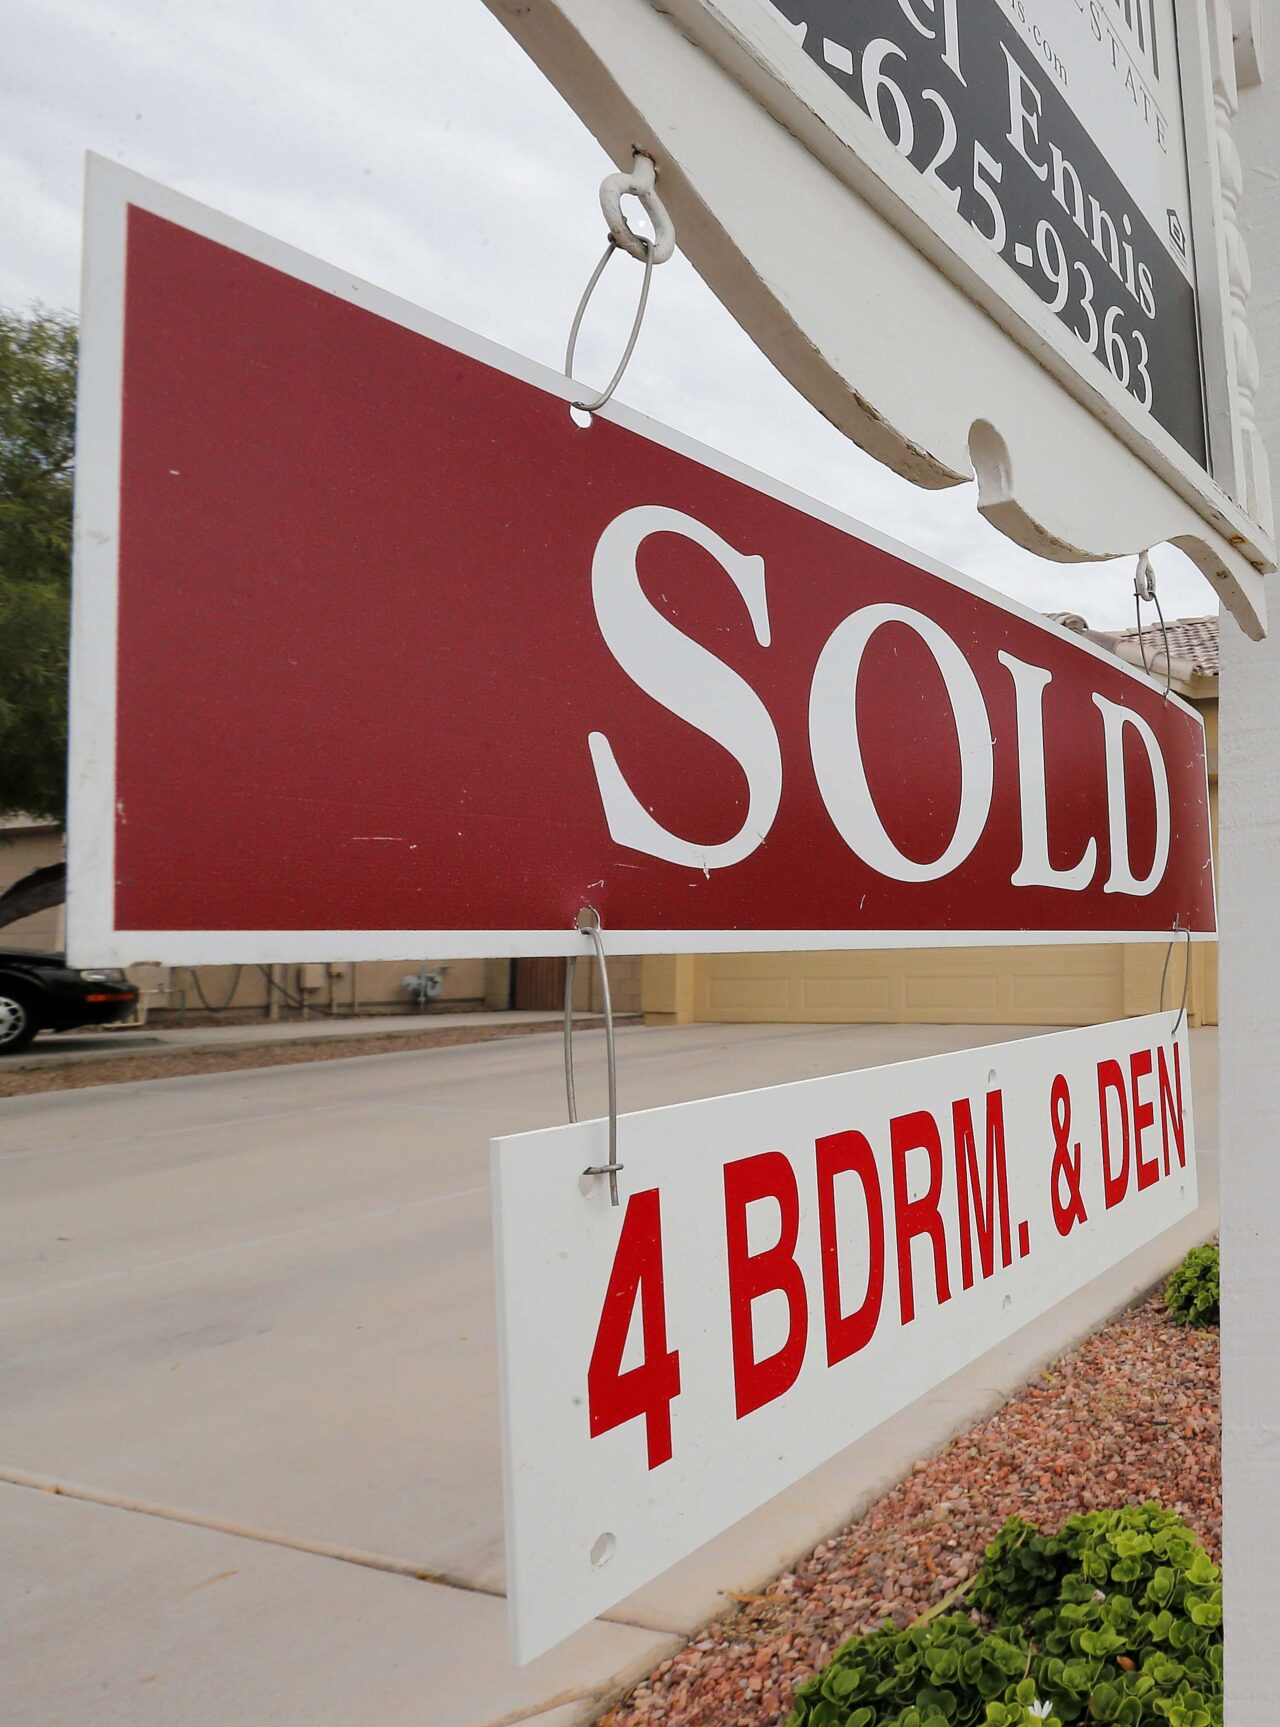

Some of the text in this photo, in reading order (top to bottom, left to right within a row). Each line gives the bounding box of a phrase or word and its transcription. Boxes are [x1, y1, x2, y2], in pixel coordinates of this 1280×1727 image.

[768, 0, 1153, 413] -625-9363
[999, 40, 1156, 320] Ennis
[1090, 1, 1167, 154] STATE
[588, 505, 1171, 897] SOLD
[588, 1042, 1186, 1470] 4 BDRM. & DEN
